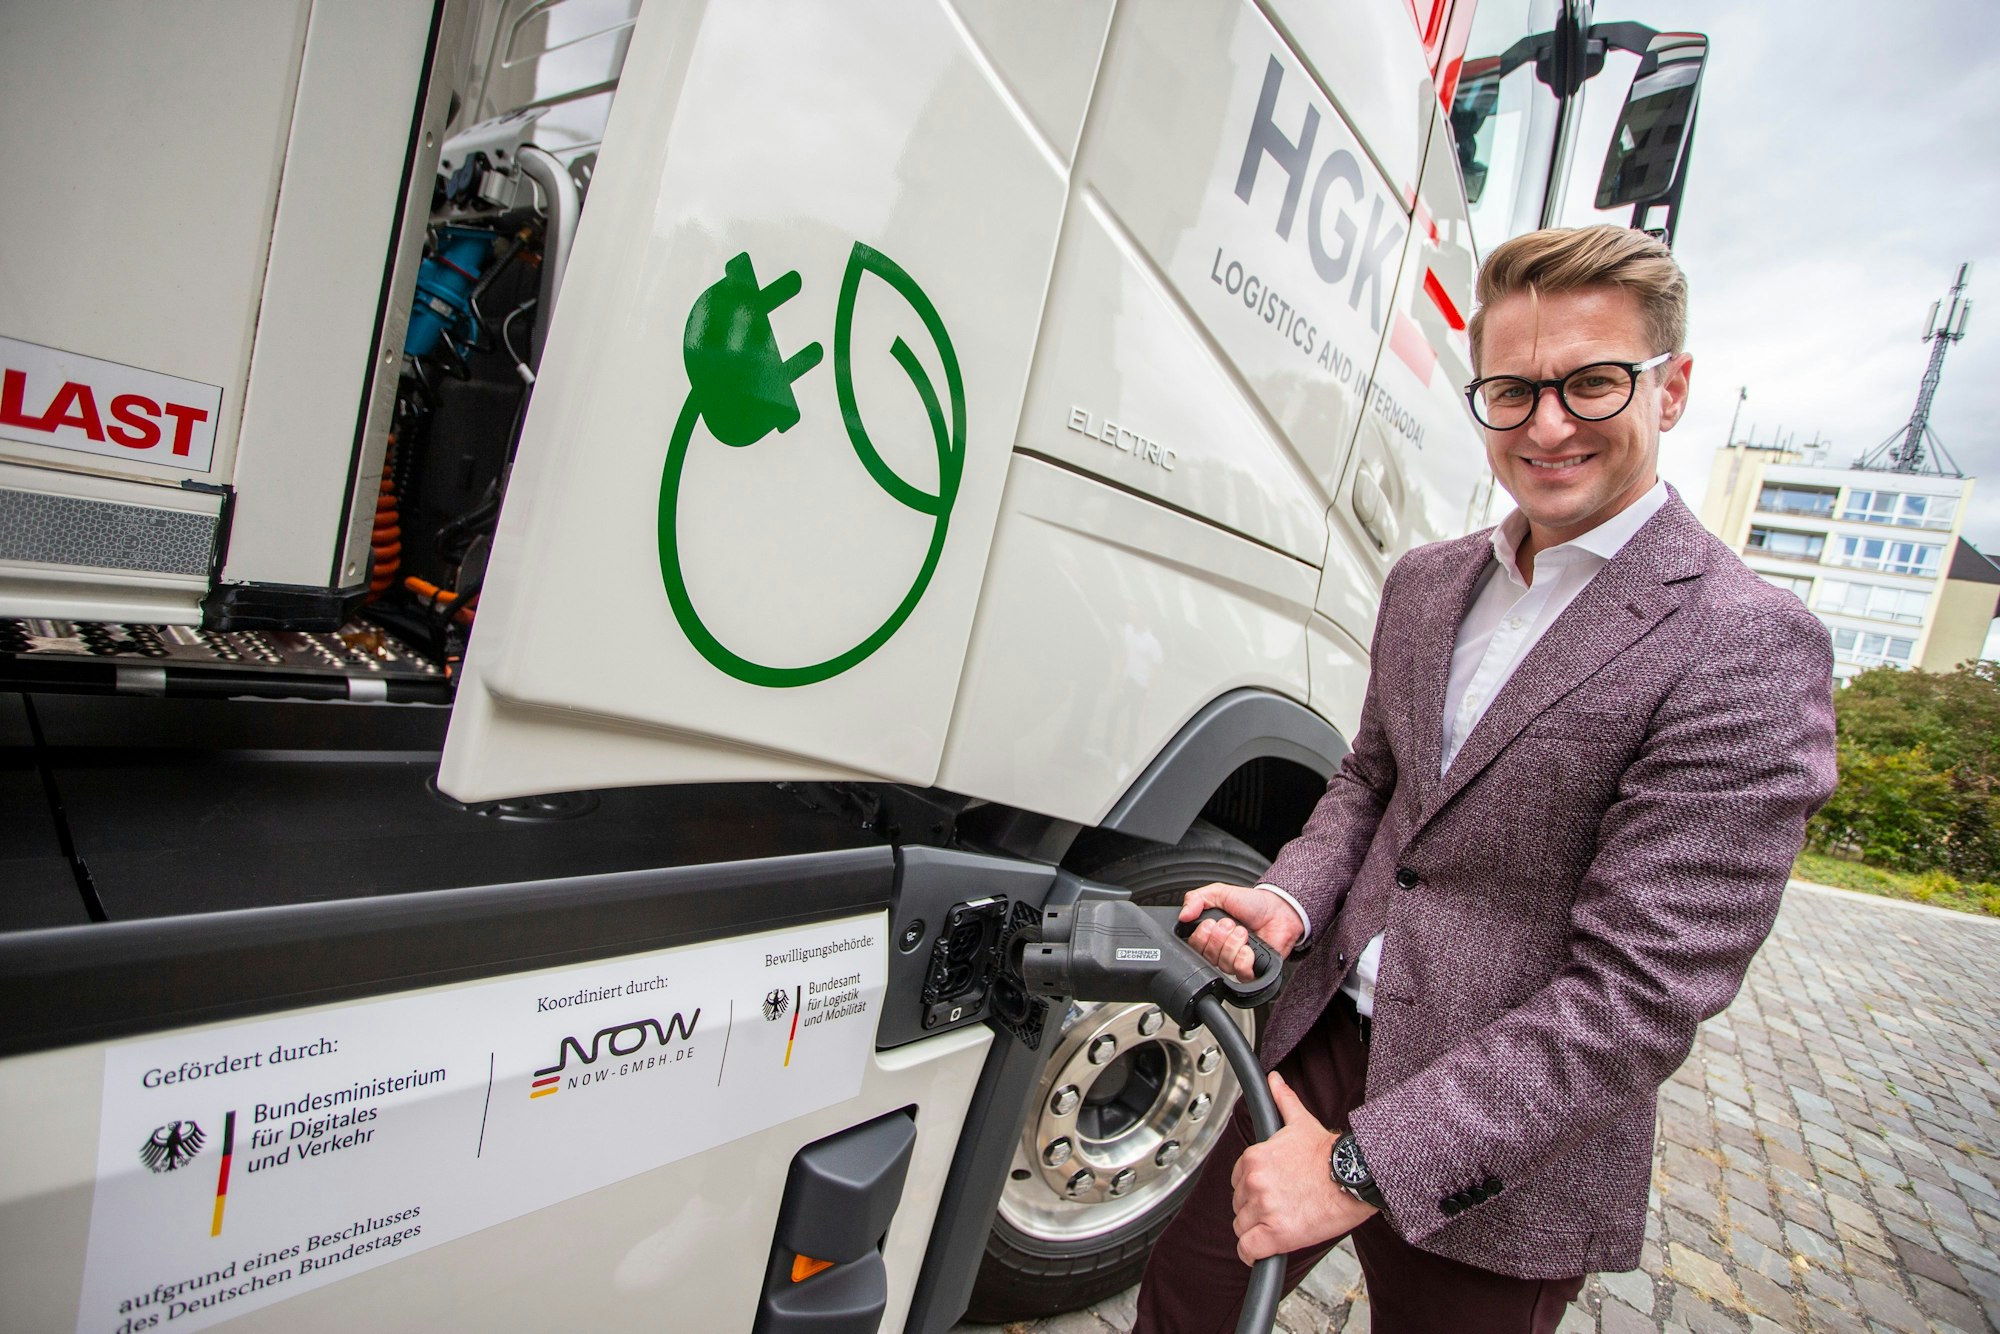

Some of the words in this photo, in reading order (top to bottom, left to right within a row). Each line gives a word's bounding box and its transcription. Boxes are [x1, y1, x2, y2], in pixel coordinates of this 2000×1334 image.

[1234, 53, 1404, 335] HGK
[1211, 247, 1317, 356] LOGISTICS
[1317, 340, 1352, 385] AND
[1354, 369, 1424, 451] INTERMODAL
[0, 368, 208, 457] LAST
[1067, 405, 1177, 472] ELECTRIC
[764, 935, 875, 968] Bewilligungsbehörde:
[536, 985, 623, 1013] Koordiniert
[625, 976, 669, 998] durch:
[806, 997, 822, 1013] für
[822, 988, 860, 1010] Logistik
[808, 972, 861, 995] Bundesamt
[803, 1012, 822, 1028] und
[824, 1001, 867, 1024] Mobilität
[142, 1050, 263, 1089] Gefördert
[269, 1037, 339, 1065] durch:
[534, 1008, 700, 1077] NOW
[567, 1047, 695, 1090] NOW-GMBH.DE
[254, 1066, 447, 1124] Bundesministerium
[247, 1150, 289, 1174] und
[297, 1127, 375, 1160] Verkehr
[250, 1128, 284, 1150] für
[289, 1104, 378, 1143] Digitales
[116, 1313, 159, 1334] des
[168, 1268, 292, 1321] Deutschen
[299, 1224, 422, 1276] Bundestages
[118, 1261, 236, 1314] aufgrund
[243, 1245, 300, 1274] eines
[306, 1205, 421, 1253] Beschlusses
